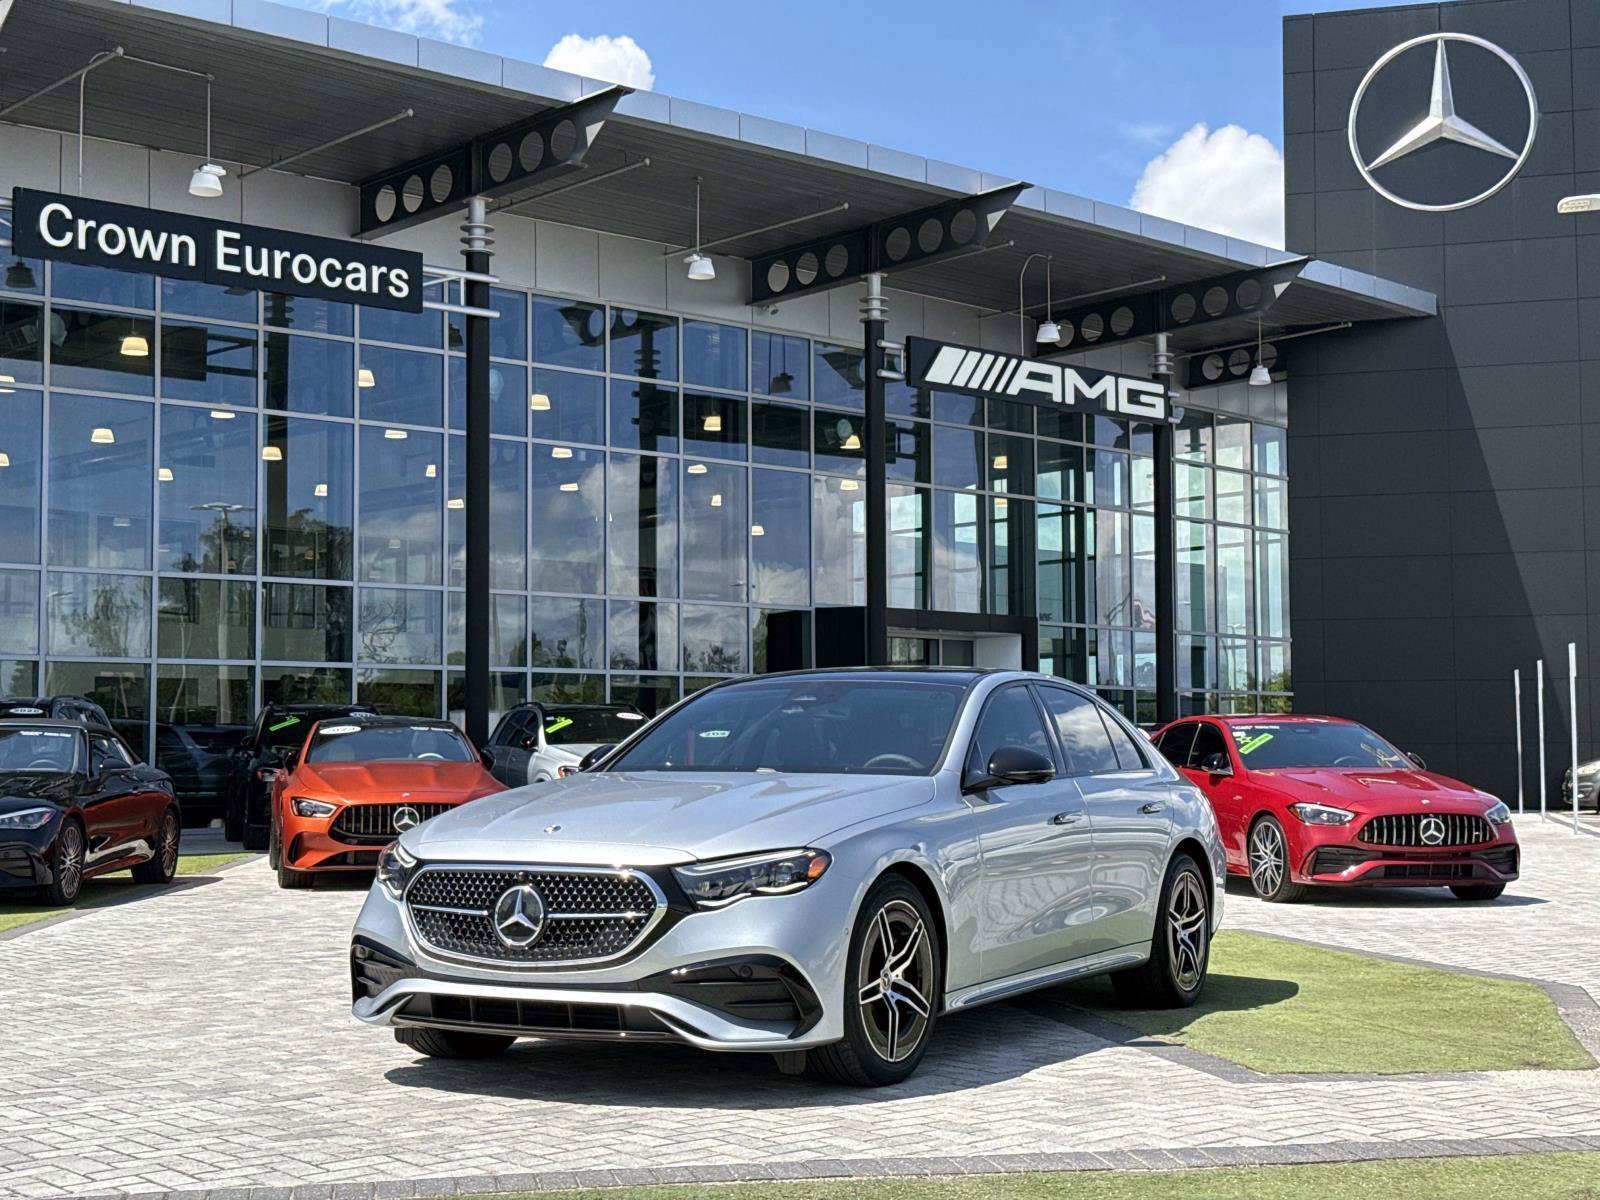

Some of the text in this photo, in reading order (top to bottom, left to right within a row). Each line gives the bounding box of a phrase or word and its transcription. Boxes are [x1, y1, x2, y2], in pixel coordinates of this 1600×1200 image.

[38, 202, 410, 298] Crown Eurocars
[1006, 360, 1165, 419] AMG
